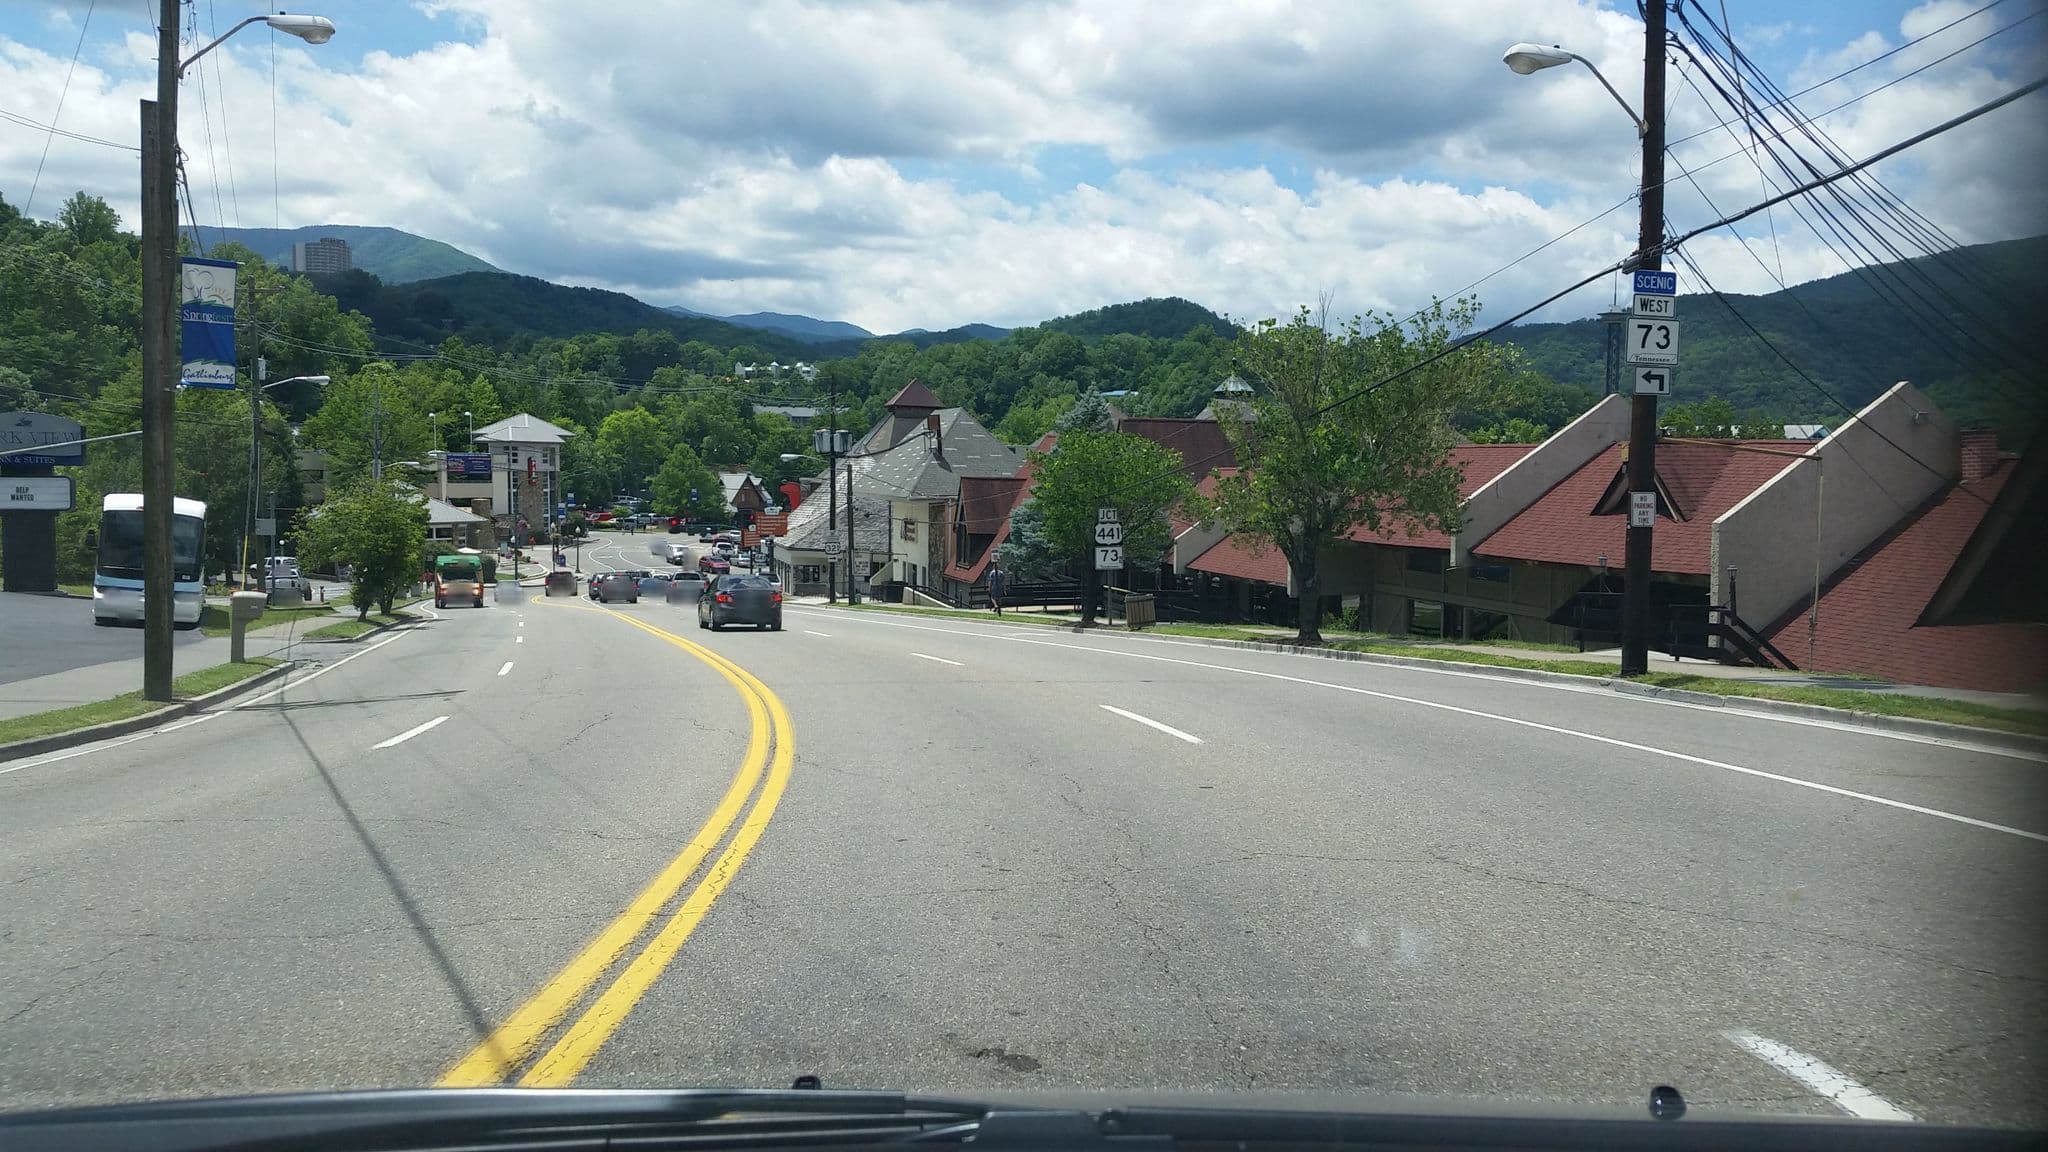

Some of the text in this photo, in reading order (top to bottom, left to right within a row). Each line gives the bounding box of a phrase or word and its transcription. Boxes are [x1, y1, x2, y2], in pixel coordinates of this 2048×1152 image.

[1637, 275, 1673, 290] SCENIC
[1640, 298, 1669, 313] WEST
[1637, 324, 1670, 350] 73
[183, 369, 234, 383] Gatlinburg
[29, 432, 78, 445] VIEW
[23, 456, 55, 464] SUITES
[1100, 510, 1116, 519] JCT
[1097, 528, 1120, 540] 441
[1100, 549, 1118, 562] 73
